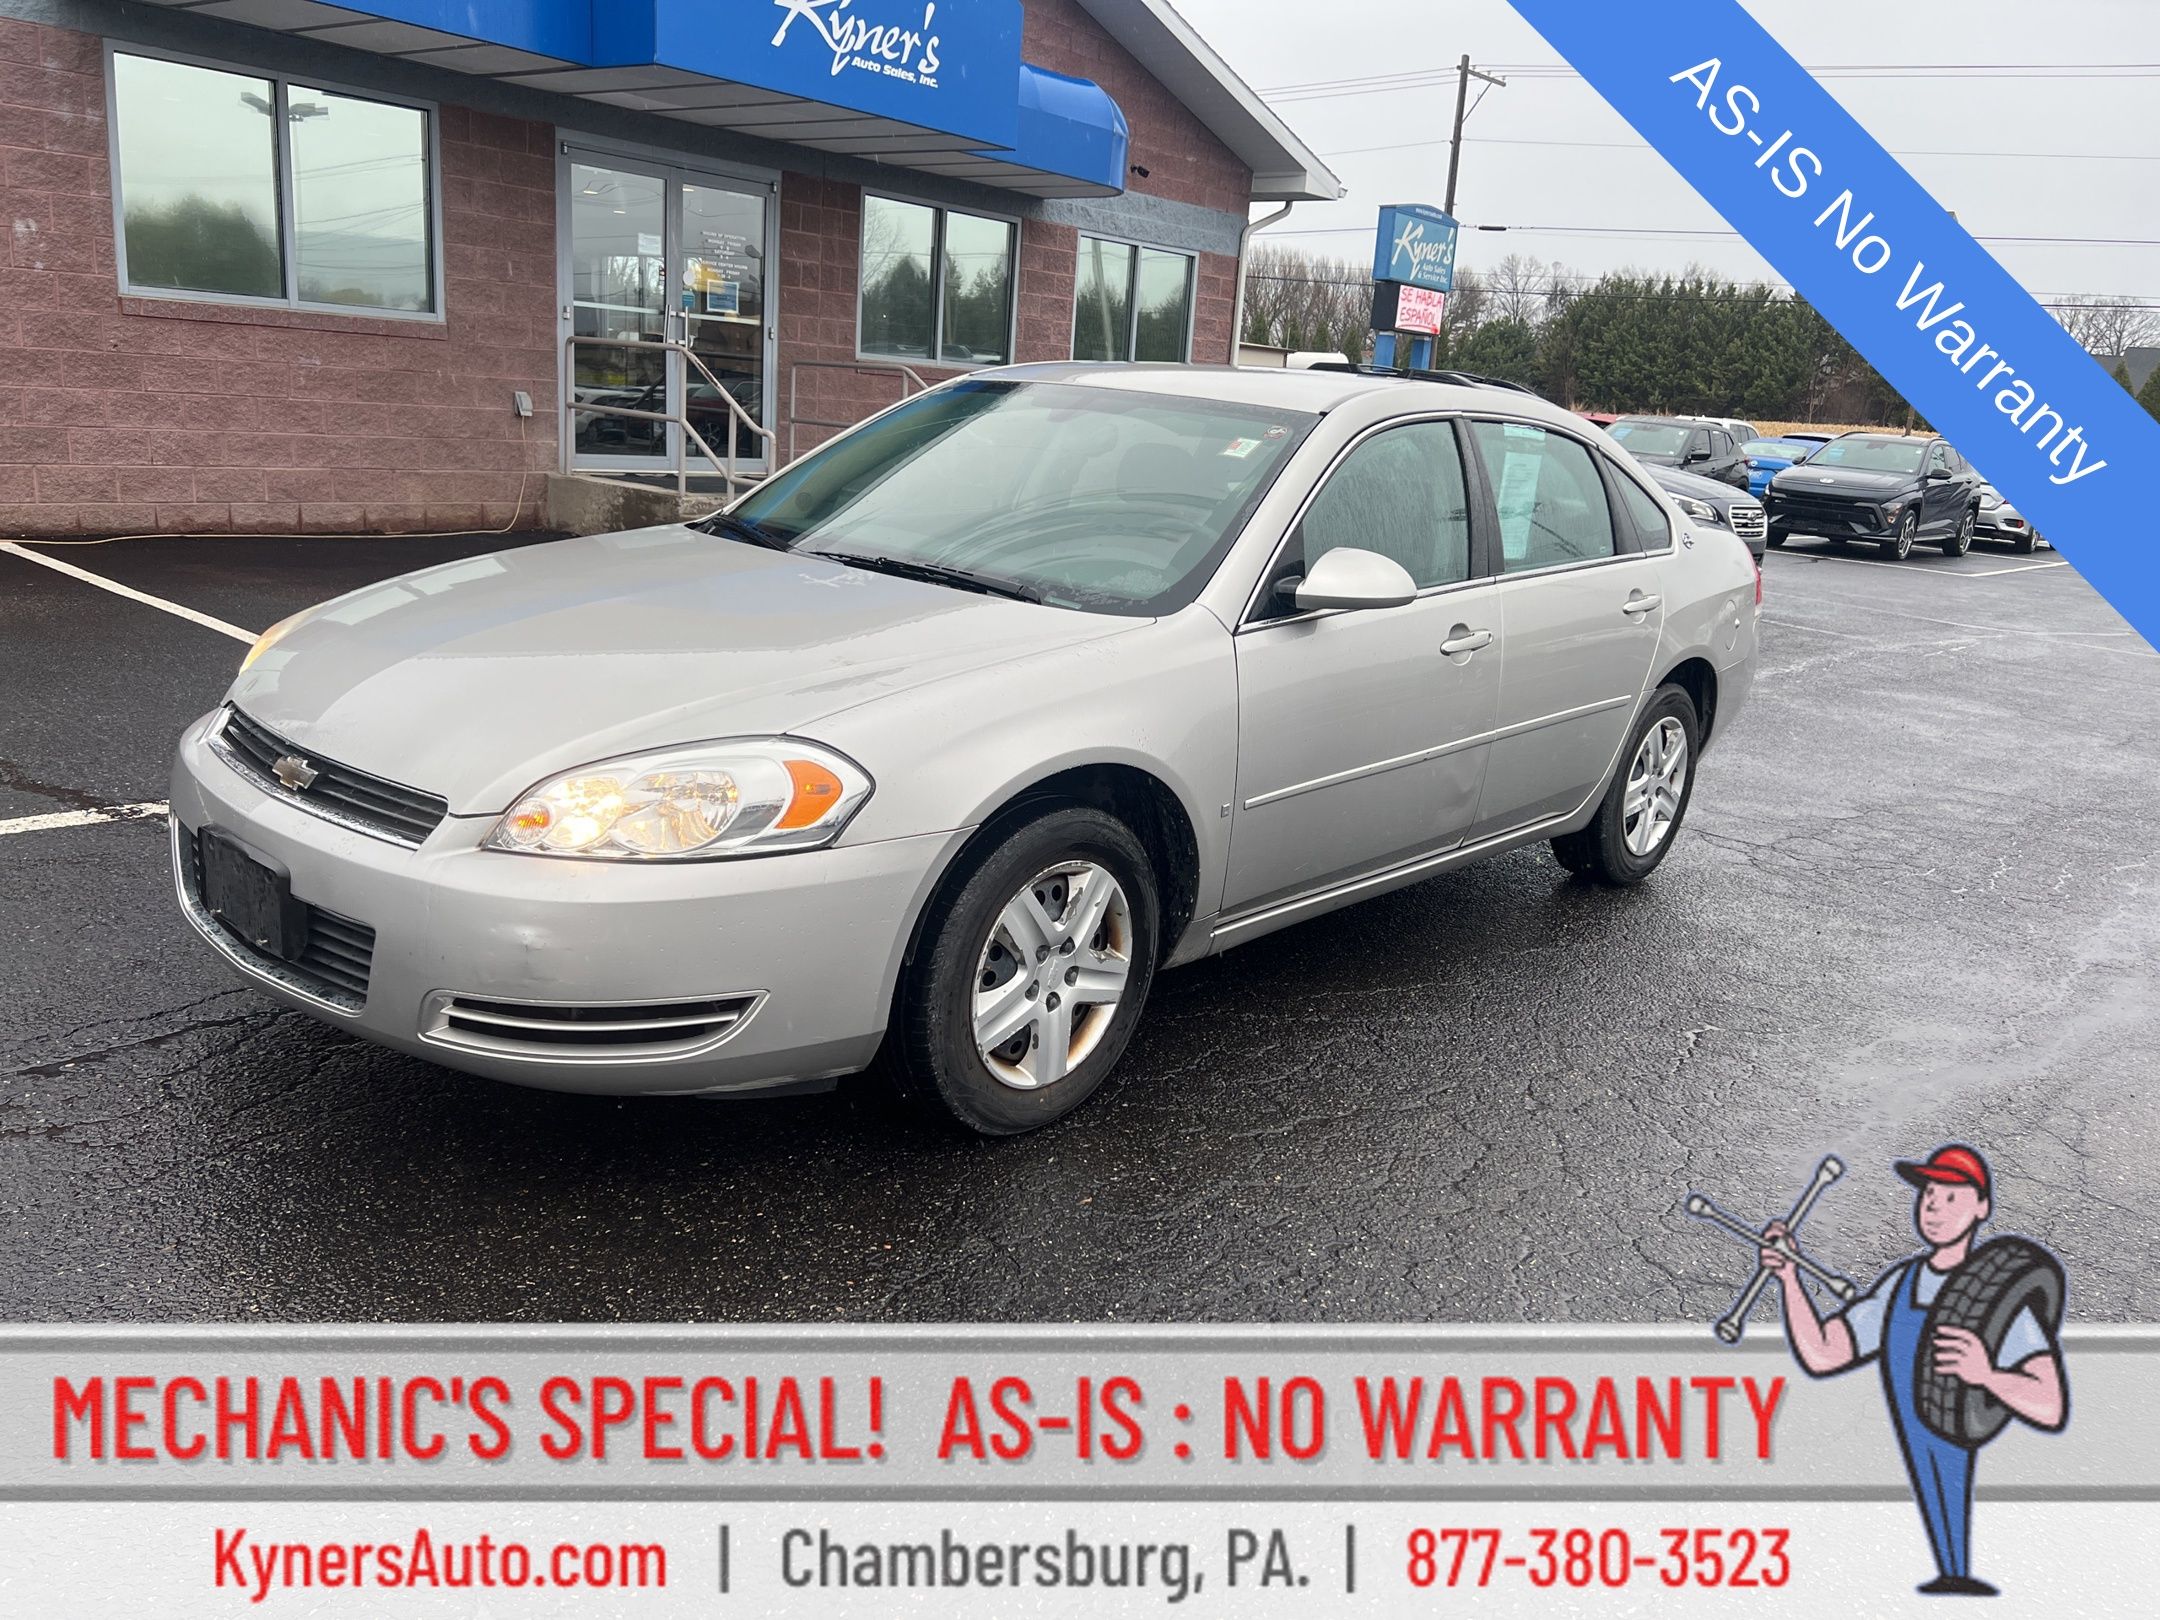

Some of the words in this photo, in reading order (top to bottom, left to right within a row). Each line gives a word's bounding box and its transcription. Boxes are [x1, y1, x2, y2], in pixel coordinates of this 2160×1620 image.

[771, 0, 940, 76] Kyner's
[851, 56, 881, 73] Auto
[882, 64, 917, 84] Sales,
[919, 74, 939, 89] Inc.
[1391, 220, 1455, 281] Kyner's
[1401, 288, 1413, 302] SE
[1416, 289, 1442, 306] HABLA
[1400, 306, 1437, 326] ESPAÑOL
